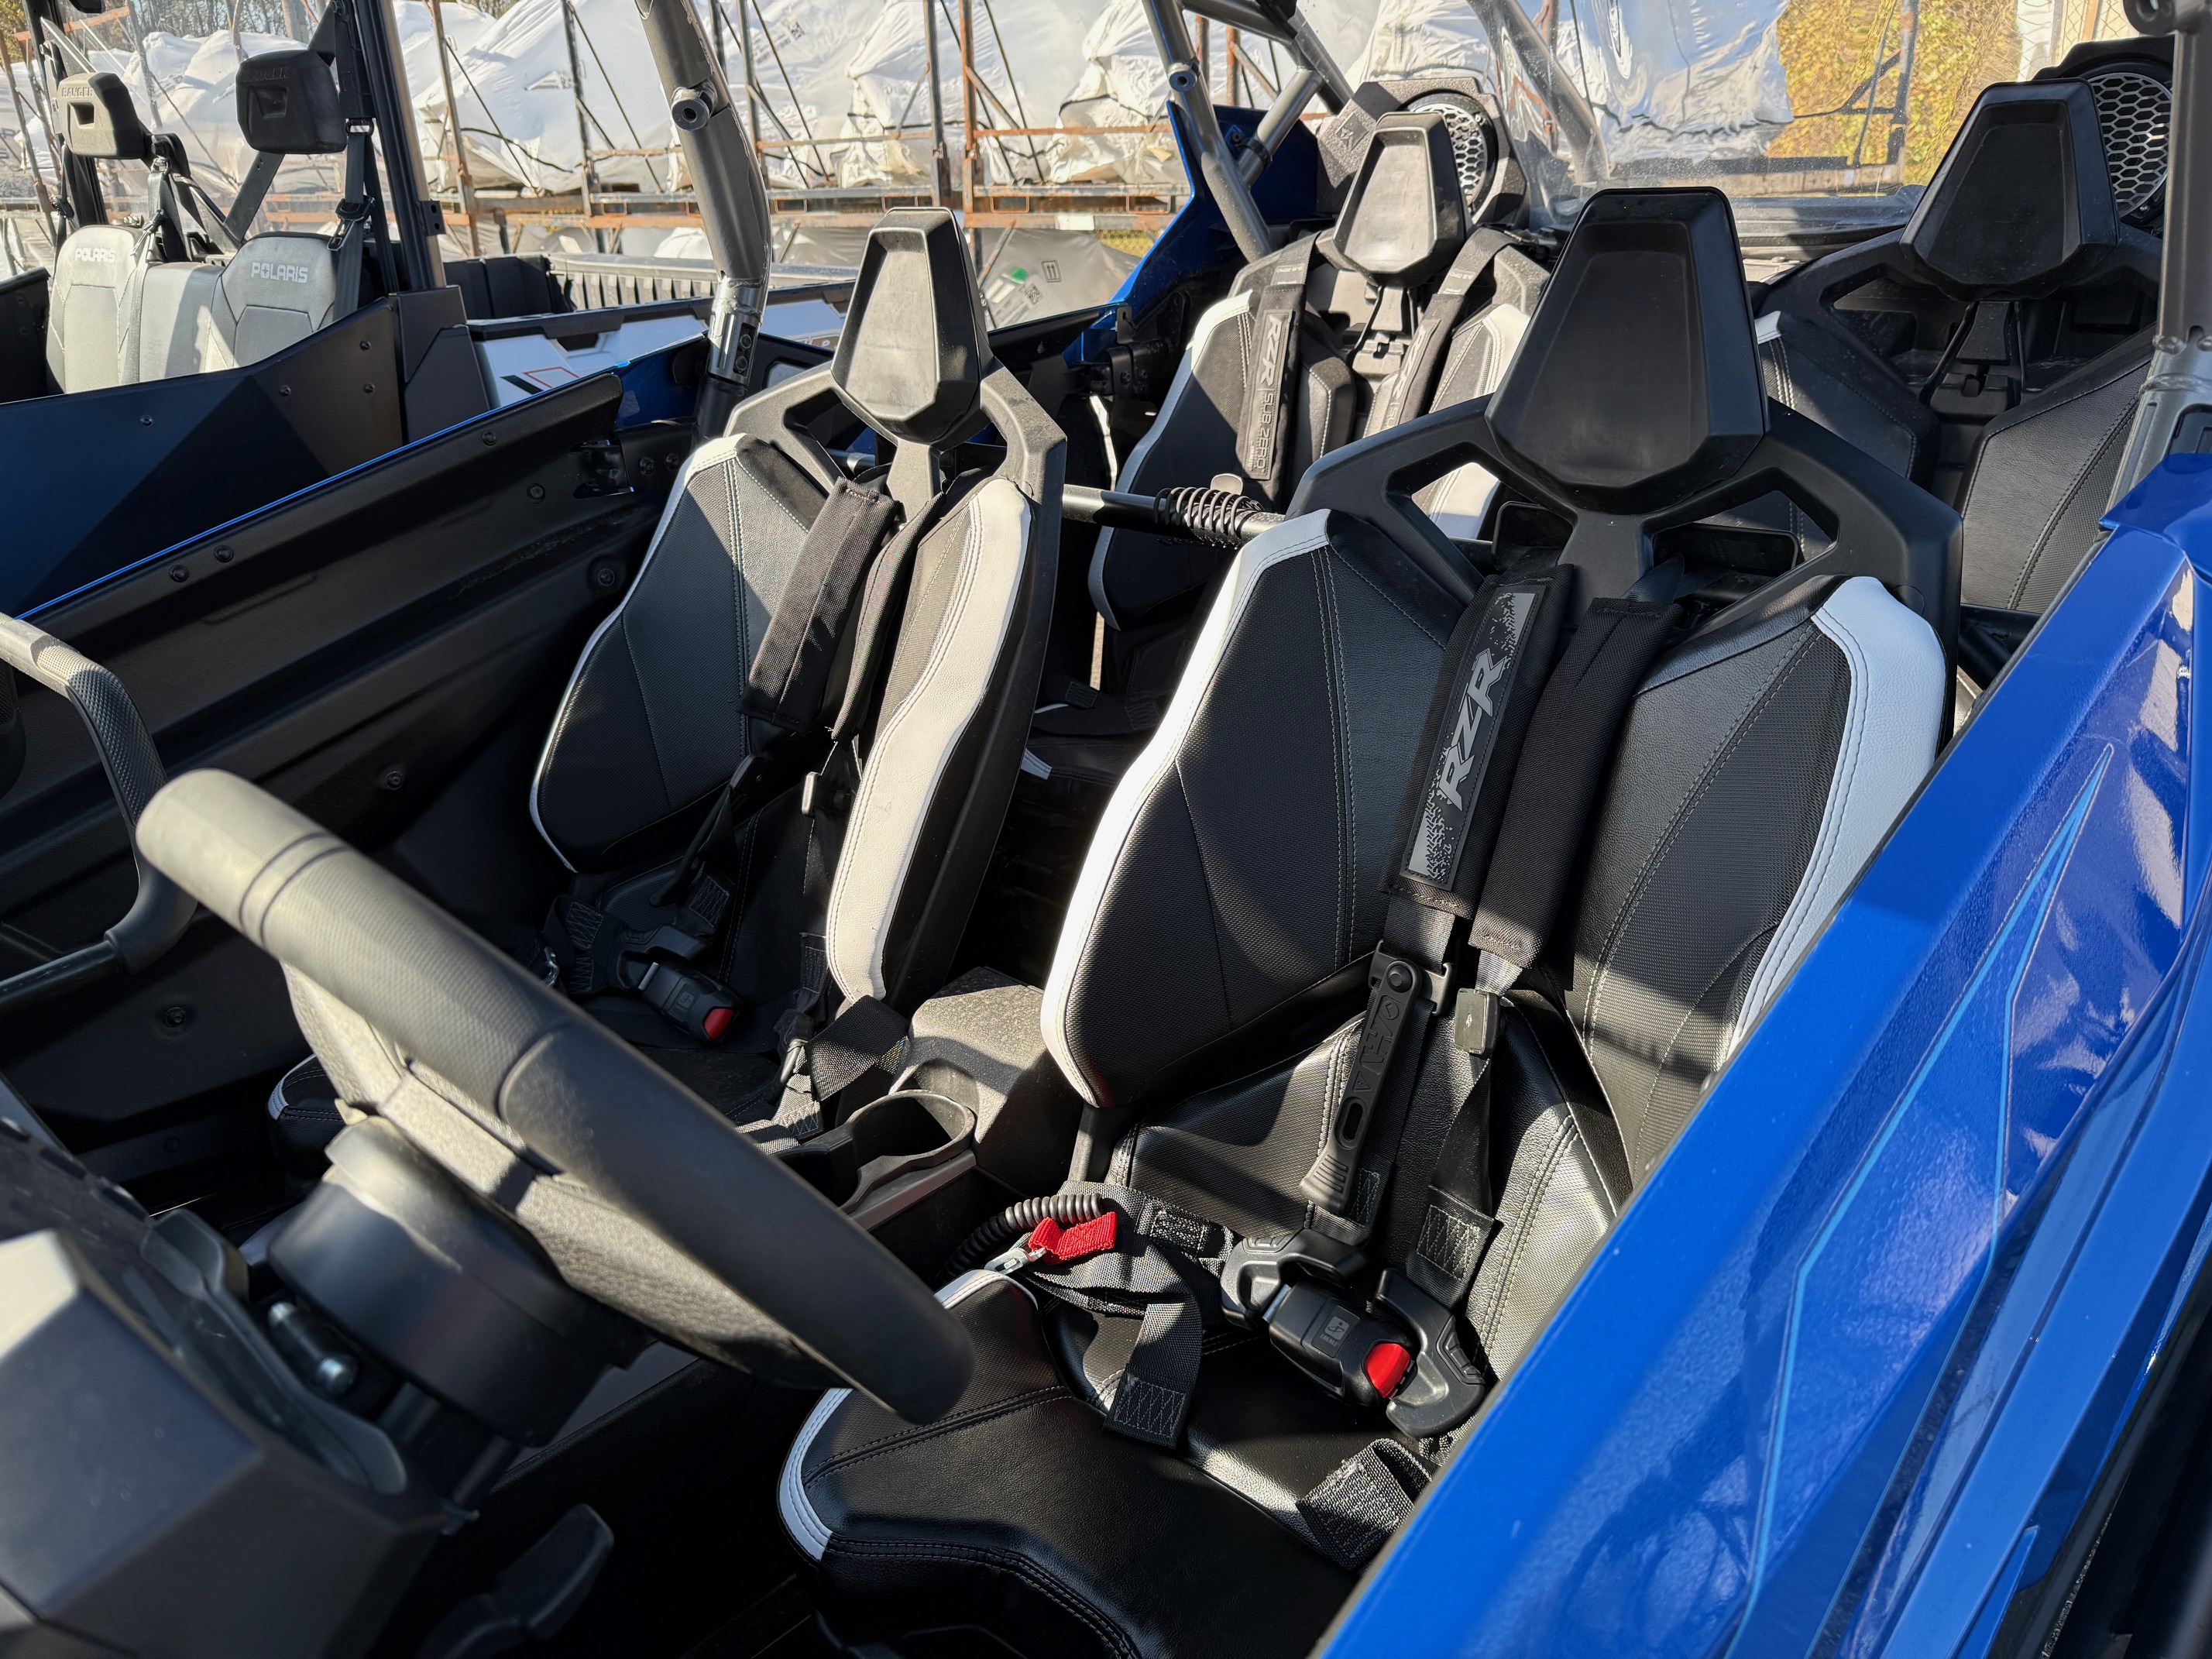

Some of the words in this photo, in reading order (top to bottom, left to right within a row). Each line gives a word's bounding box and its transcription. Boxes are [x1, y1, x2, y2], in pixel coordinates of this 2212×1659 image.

[62, 87, 93, 98] RANGER
[75, 247, 117, 263] POLARIS
[251, 262, 308, 283] POLARIS
[1260, 314, 1283, 386] RZR
[1262, 393, 1274, 424] SUB
[1255, 431, 1270, 470] ZERO
[1439, 647, 1509, 812] RZR
